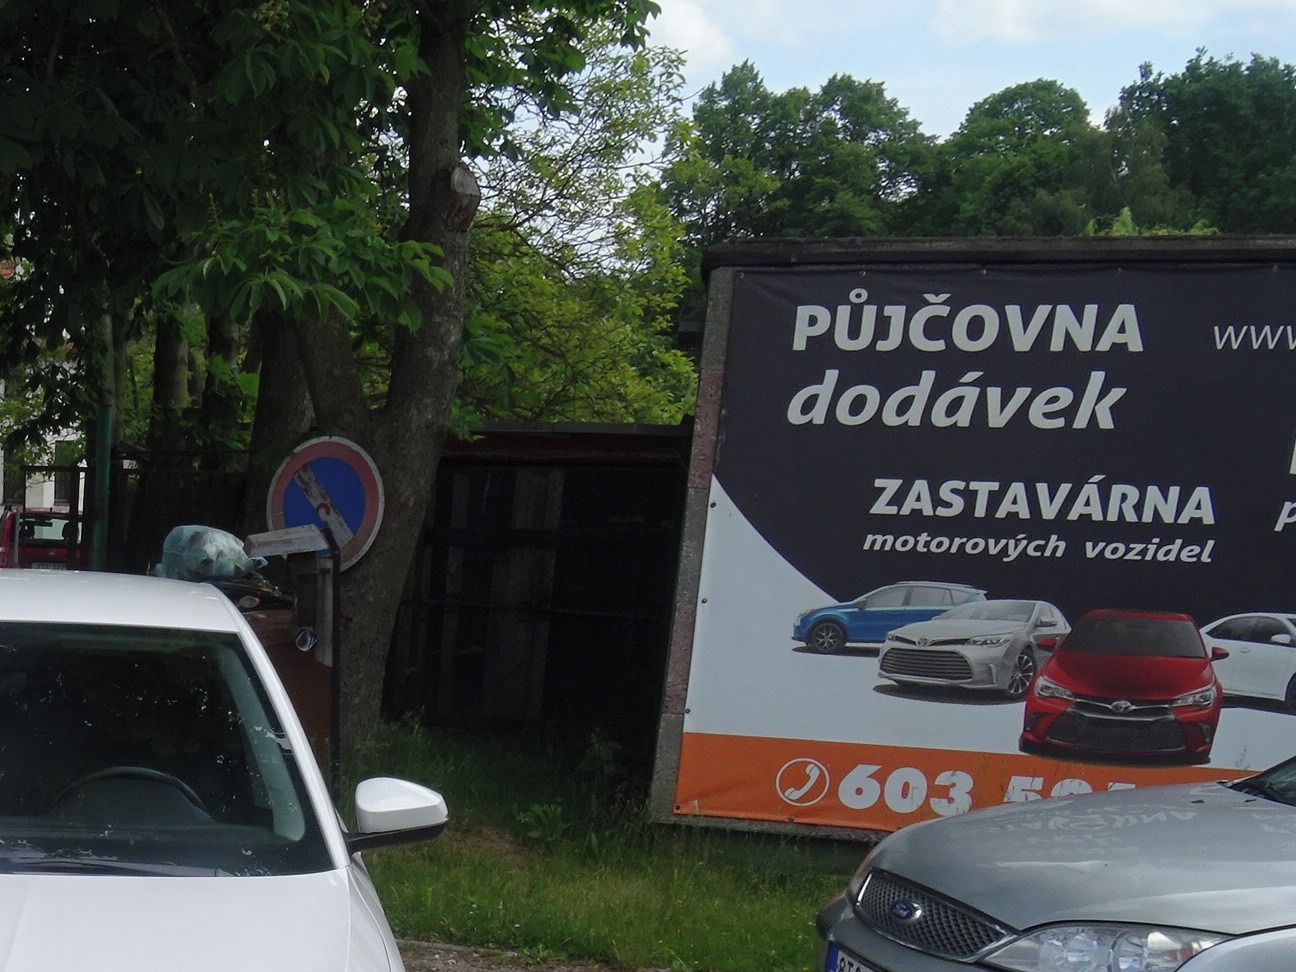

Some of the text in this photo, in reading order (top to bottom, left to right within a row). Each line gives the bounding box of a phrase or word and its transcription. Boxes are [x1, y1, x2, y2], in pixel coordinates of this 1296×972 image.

[792, 288, 1144, 353] PŮJČOVNA
[787, 369, 1127, 430] dodávek
[869, 474, 1216, 524] ZASTAVÁRNA
[863, 533, 1215, 563] motorových vozidel
[838, 764, 973, 816] 603
